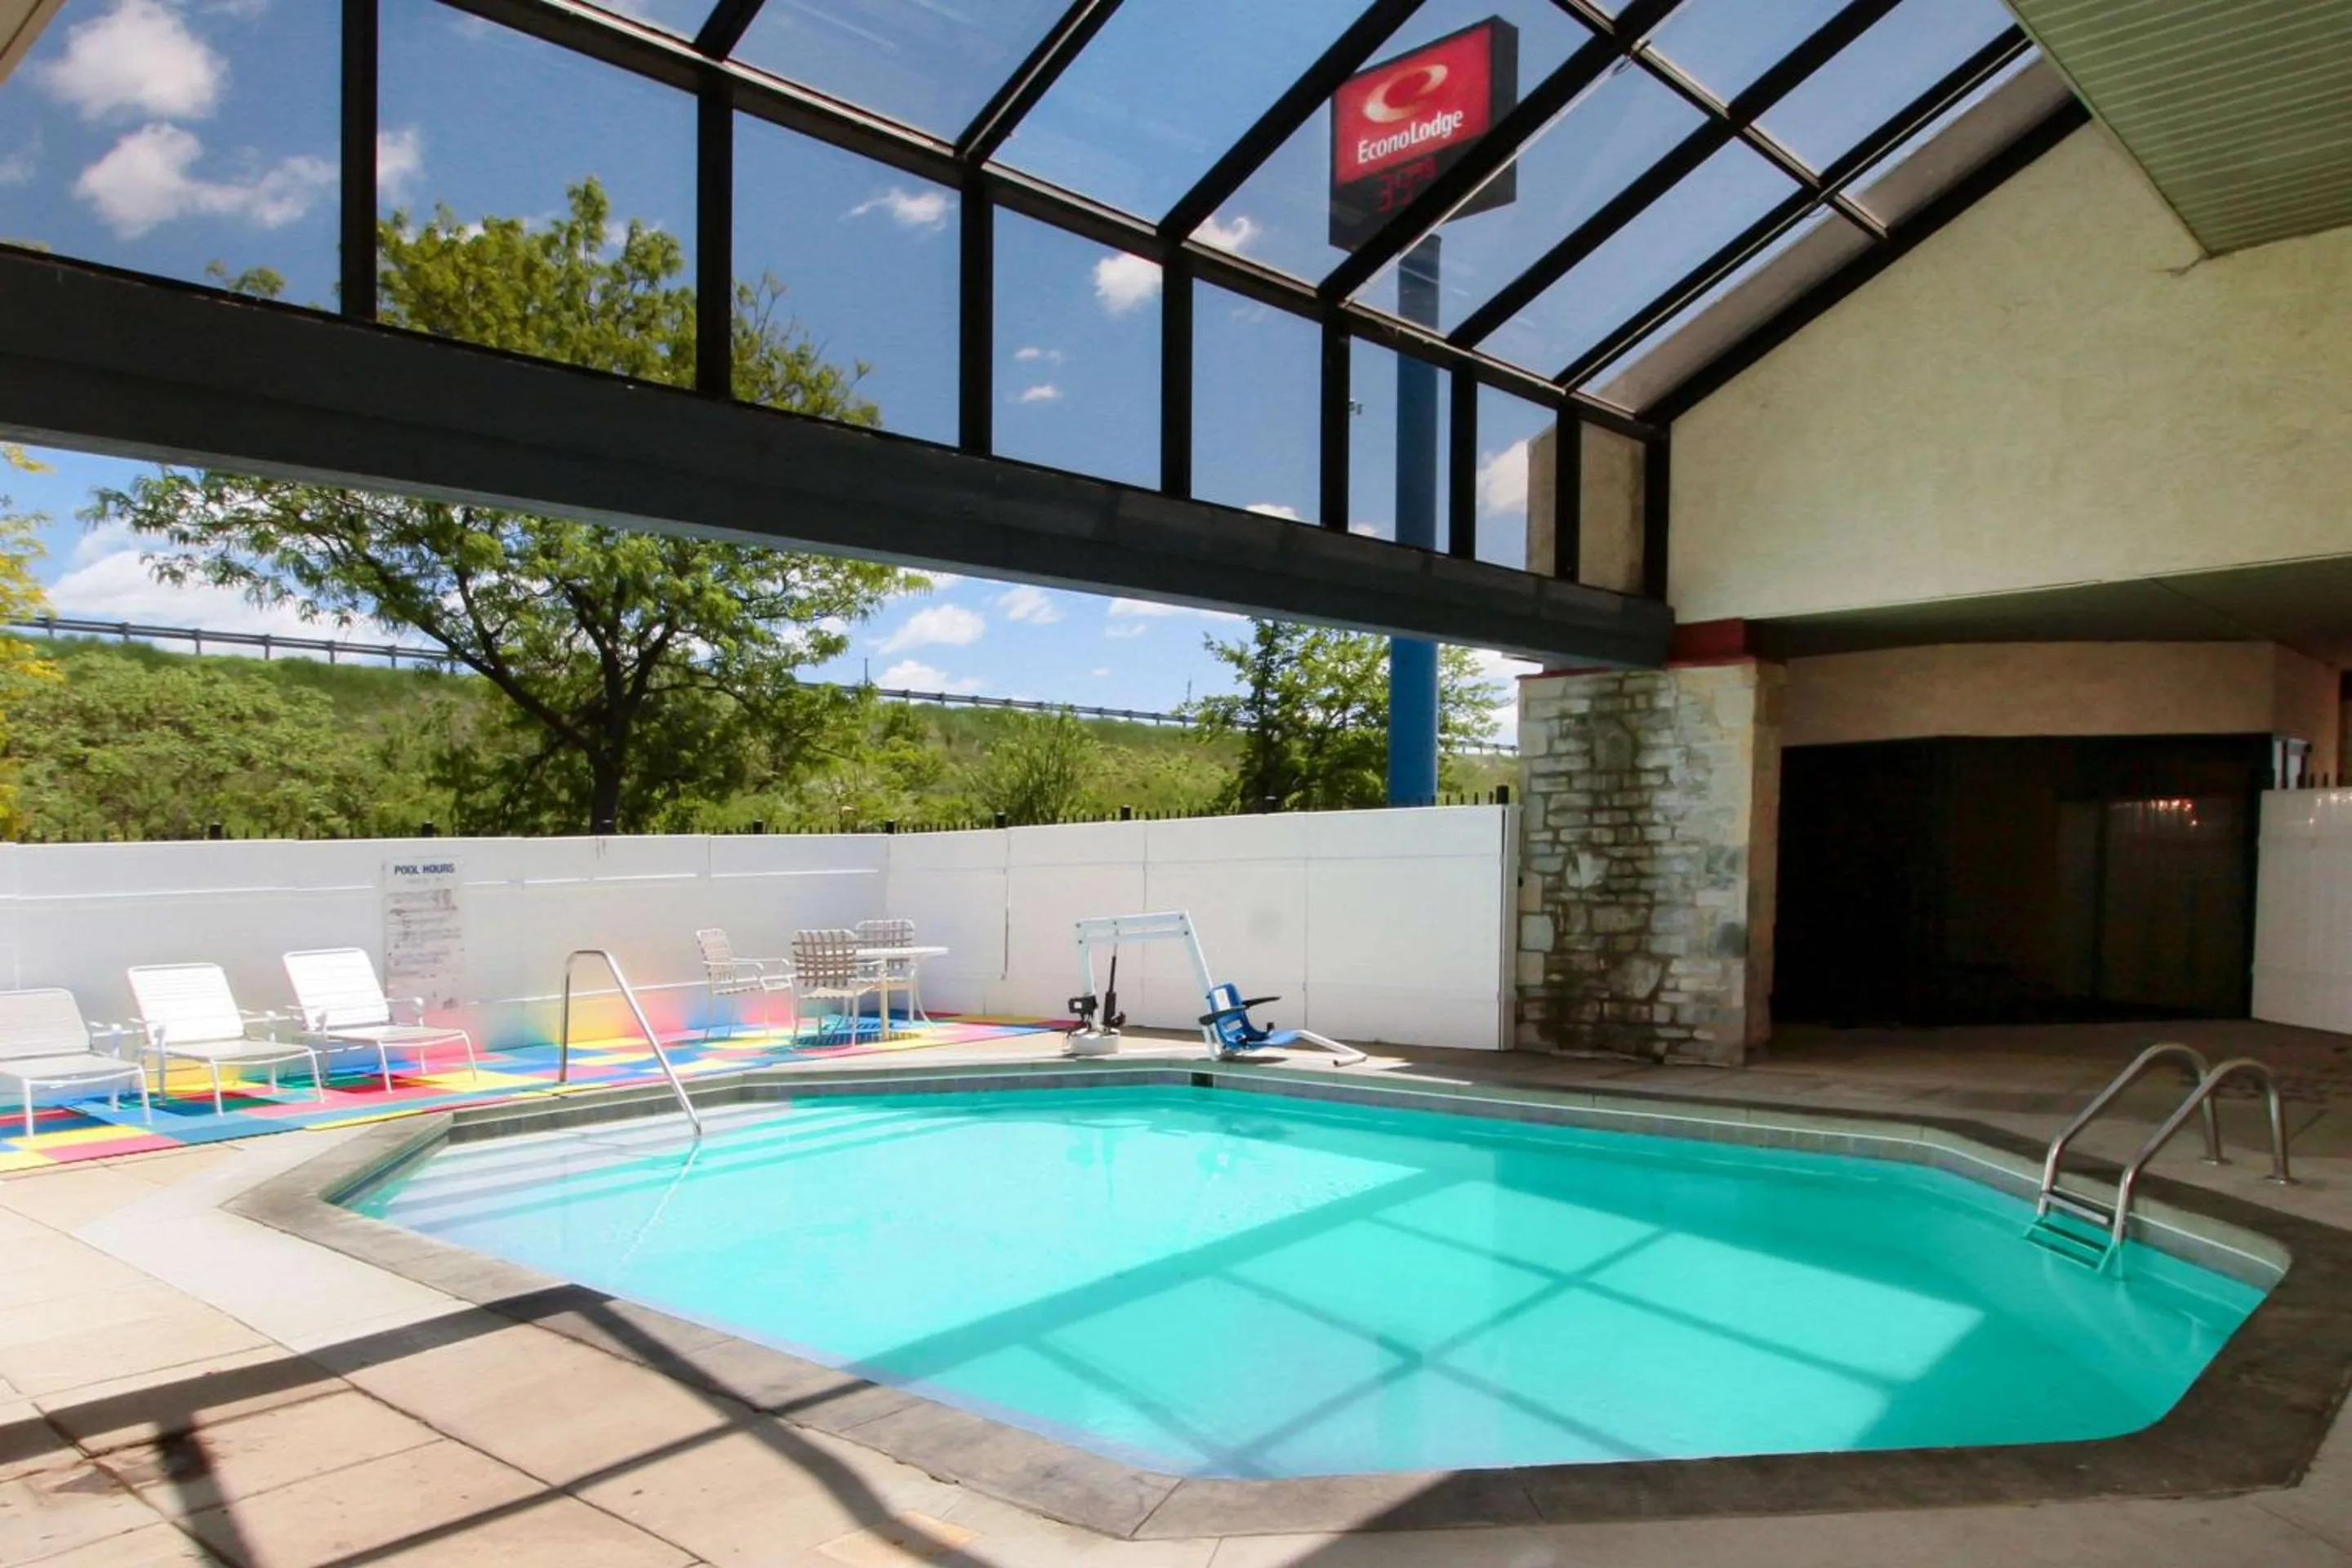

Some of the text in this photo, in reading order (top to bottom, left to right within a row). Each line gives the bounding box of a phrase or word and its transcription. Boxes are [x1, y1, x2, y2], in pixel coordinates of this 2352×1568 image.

[1356, 109, 1463, 164] EconoLodge
[394, 862, 455, 875] POOL HOURS
